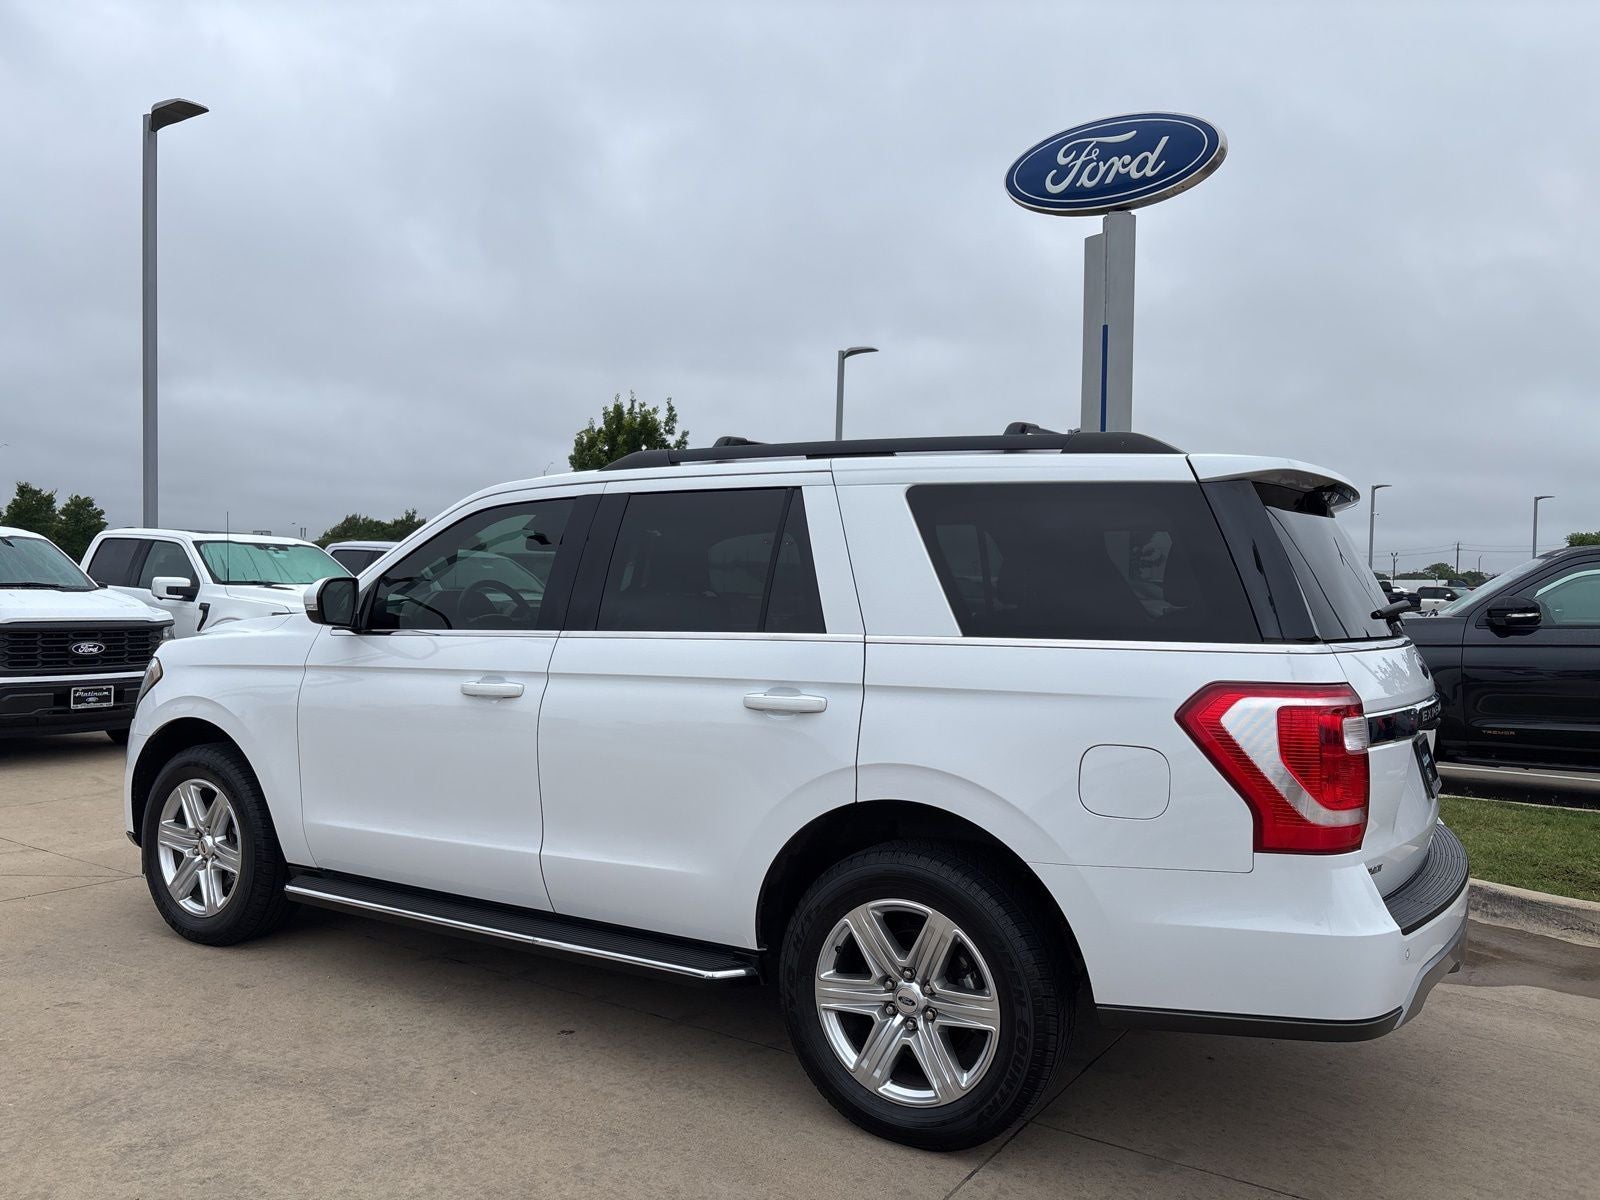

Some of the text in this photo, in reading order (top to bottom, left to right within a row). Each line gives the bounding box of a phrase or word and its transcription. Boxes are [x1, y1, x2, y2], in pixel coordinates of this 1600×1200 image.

[1045, 130, 1170, 194] Ford
[79, 643, 99, 653] Ford
[74, 690, 110, 698] Platinum
